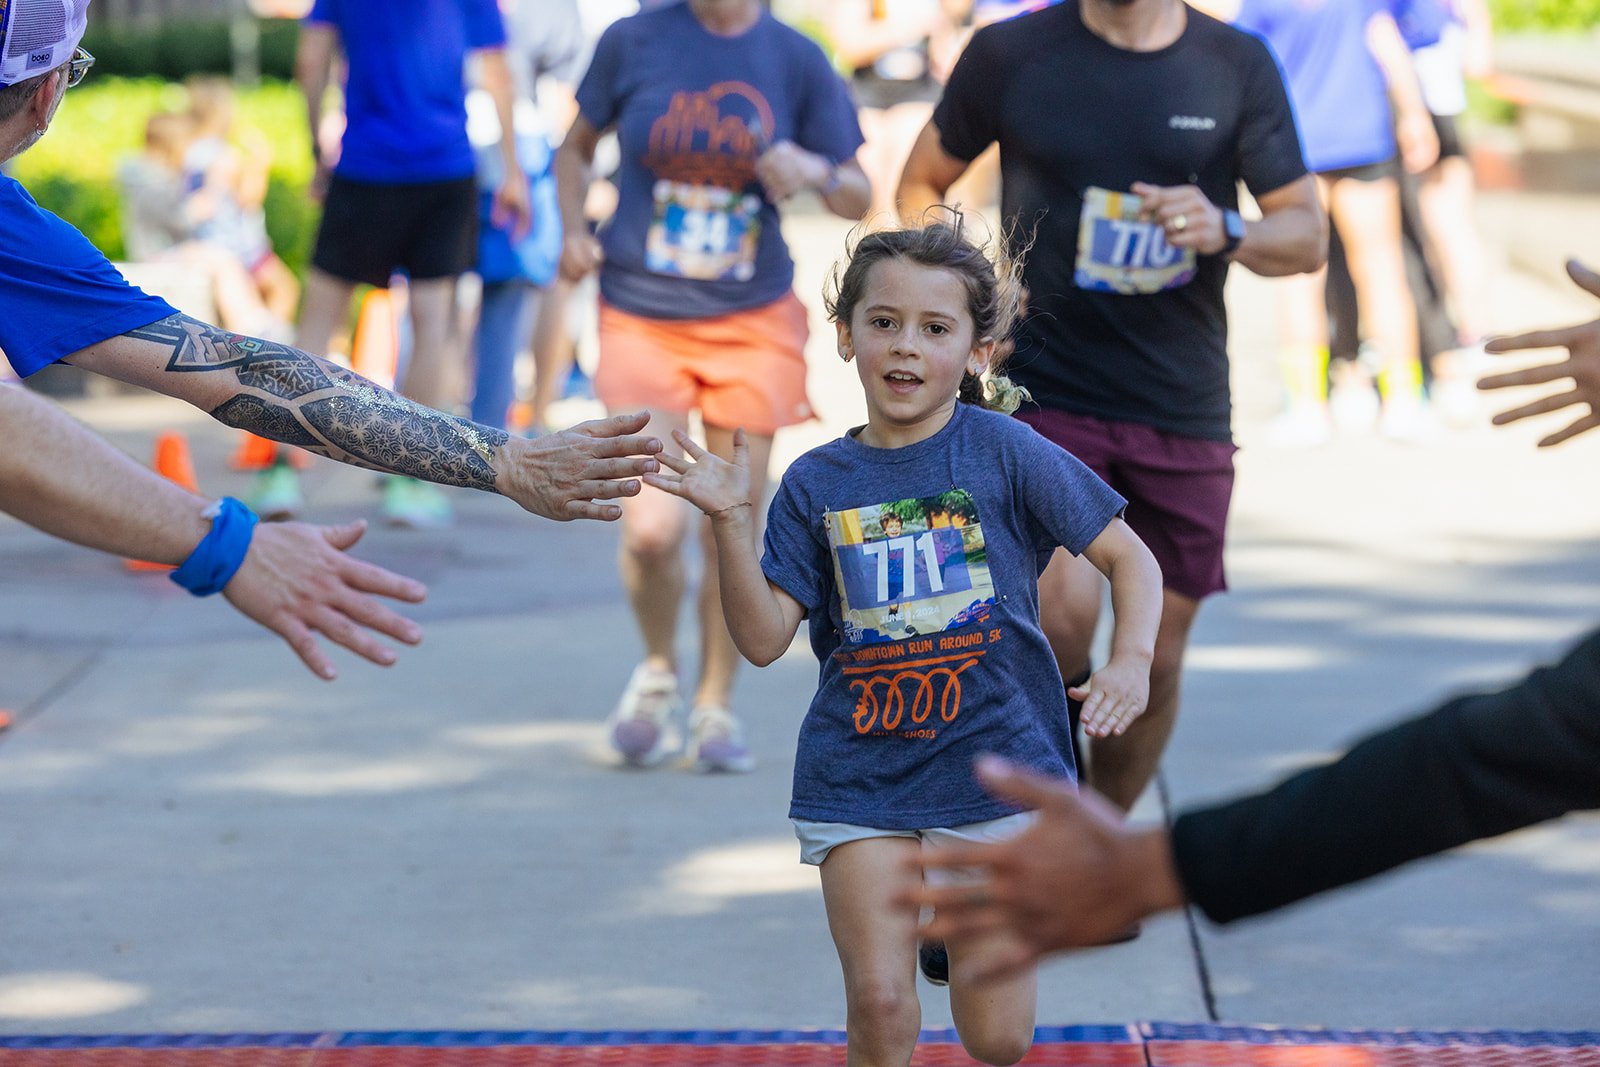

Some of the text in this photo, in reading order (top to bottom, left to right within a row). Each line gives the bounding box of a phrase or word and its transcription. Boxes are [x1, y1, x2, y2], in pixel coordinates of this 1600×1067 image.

[1110, 221, 1174, 266] 770
[862, 532, 943, 602] 771
[880, 612, 904, 623] JUNE
[852, 645, 904, 661] DOWNTOWN
[908, 640, 933, 654] RUN
[939, 632, 983, 650] AROUND
[988, 628, 1002, 644] 5K
